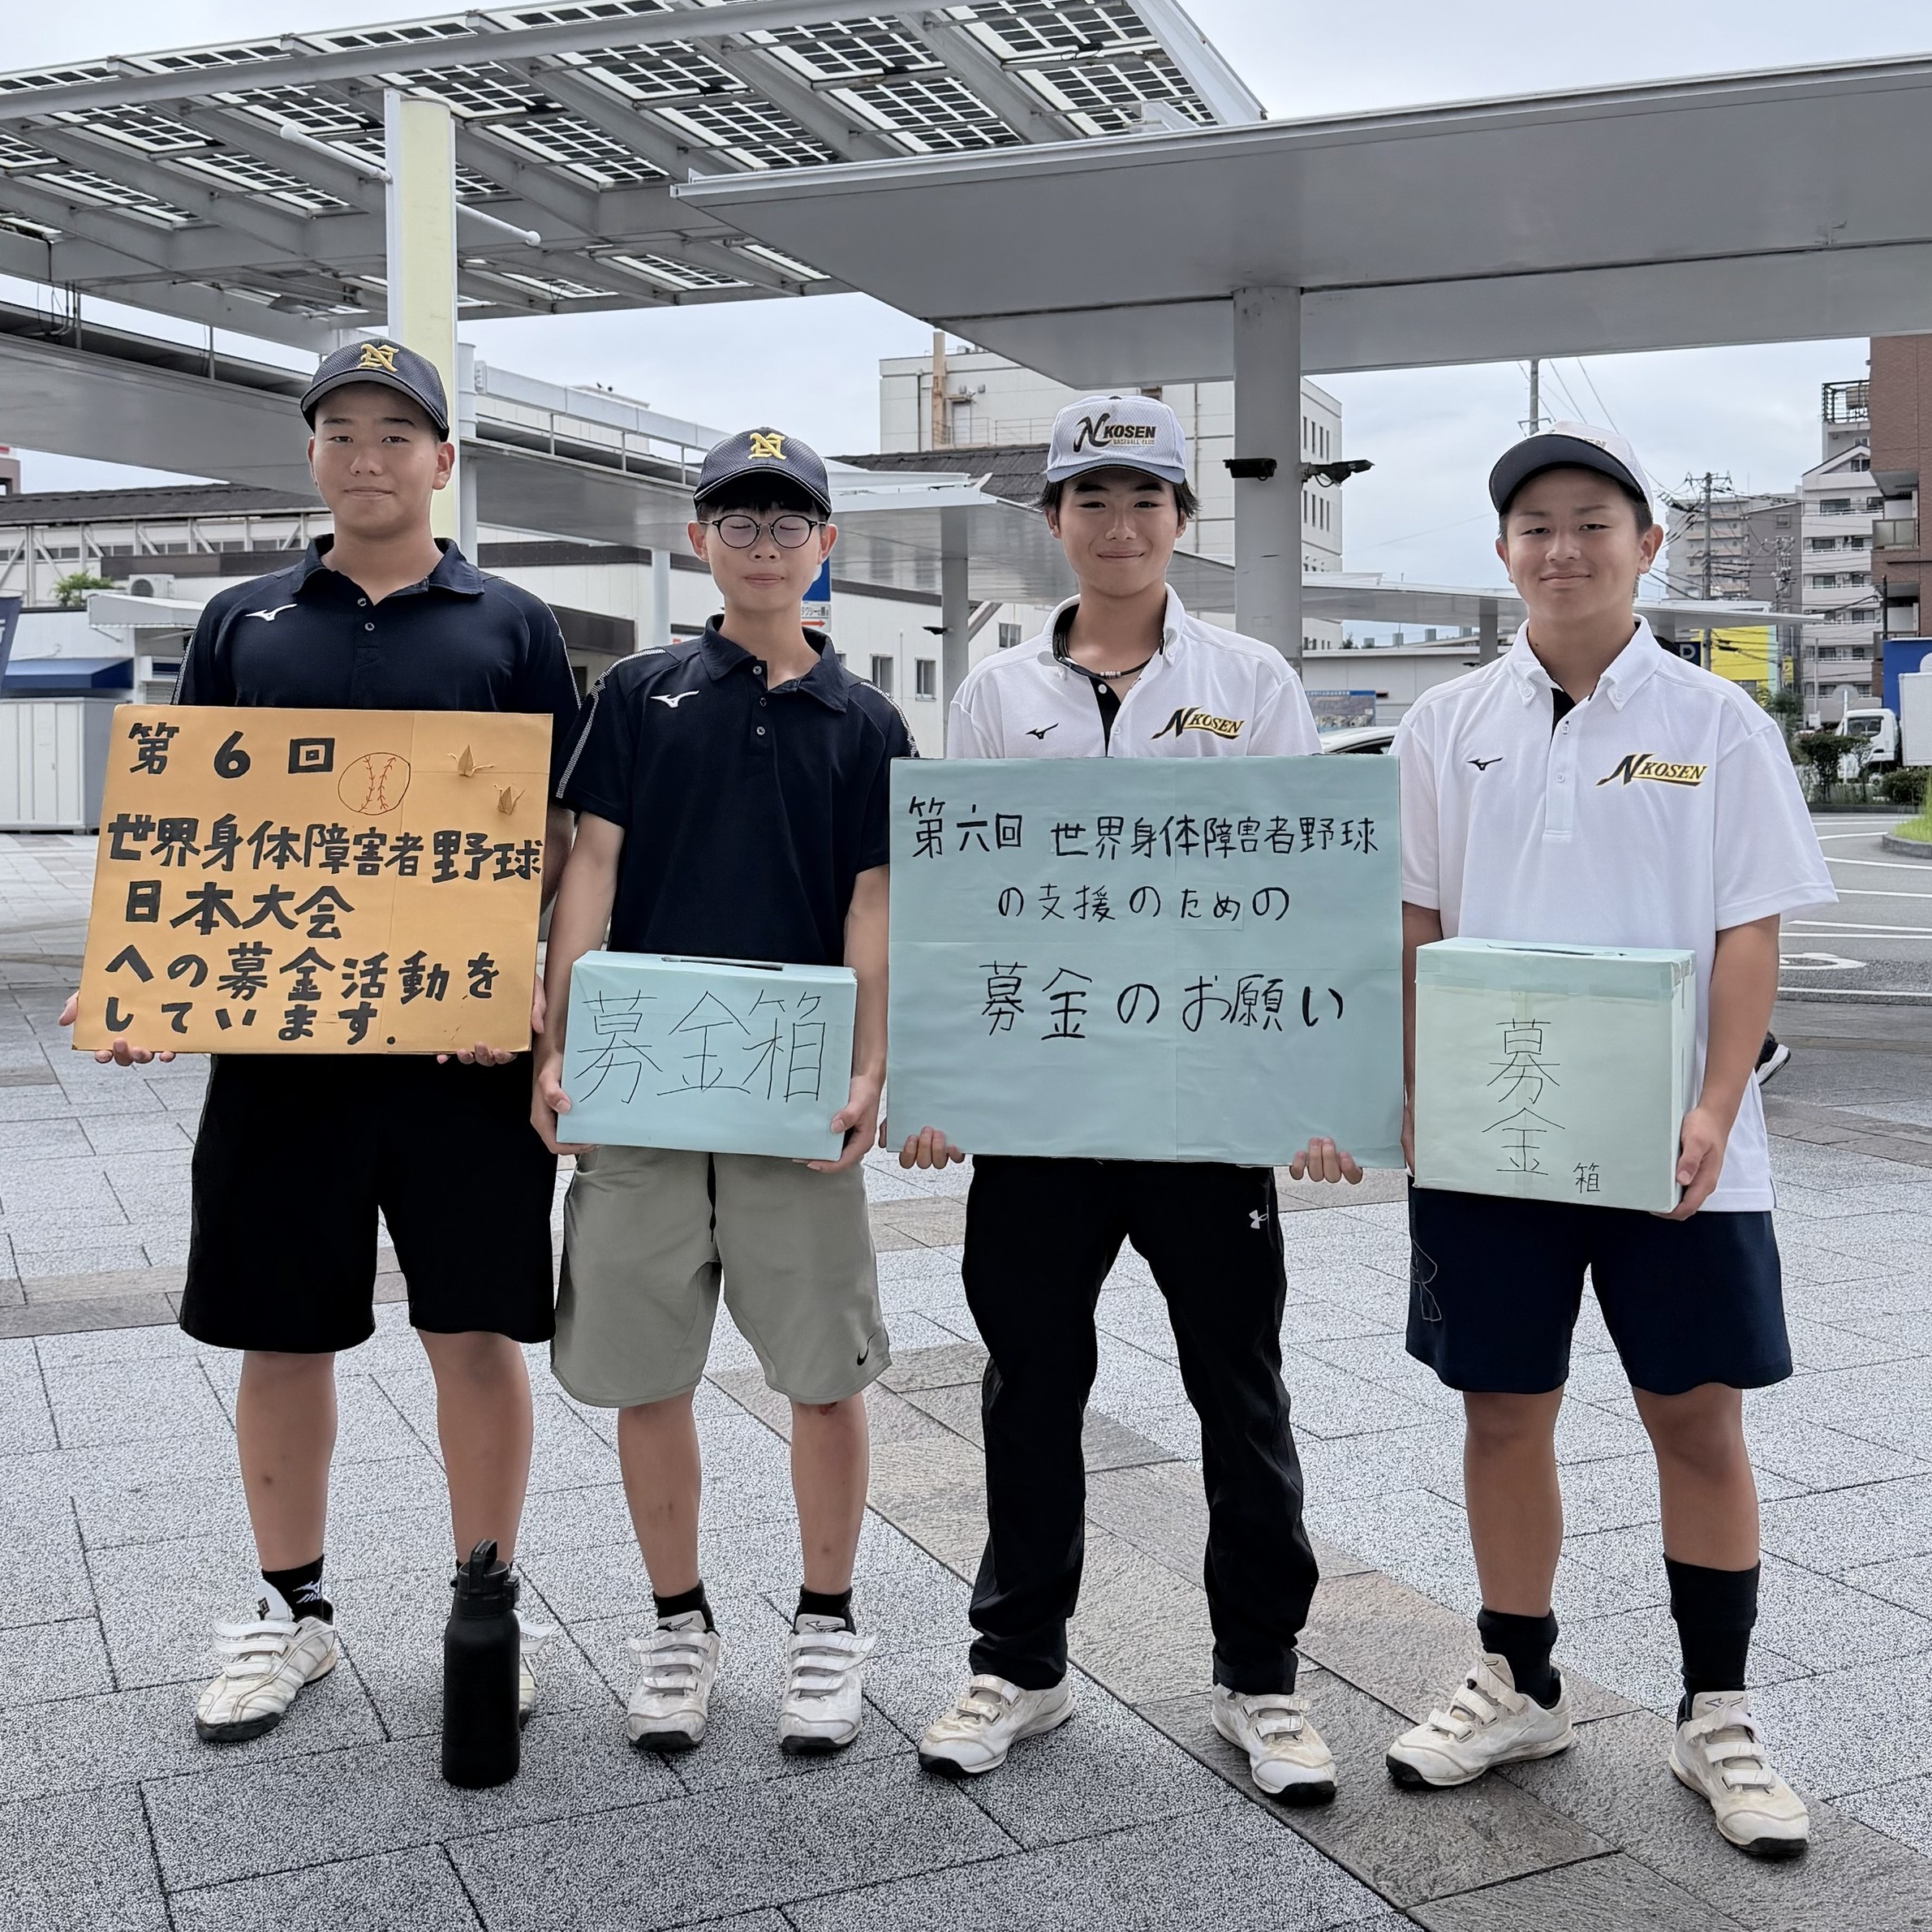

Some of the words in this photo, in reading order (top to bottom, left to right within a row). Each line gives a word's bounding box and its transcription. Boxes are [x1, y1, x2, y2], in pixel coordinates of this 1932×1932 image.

[106, 812, 544, 884] 世界身体障害者野球
[908, 796, 1023, 859] 第六回
[1050, 814, 1379, 860] 世界身体障害者野球
[125, 880, 355, 940] 日本大会
[997, 883, 1290, 923] の支援のための
[979, 960, 1344, 1041] 募金のお願い
[574, 988, 826, 1104] 募金箱
[1573, 1162, 1601, 1194] 箱
